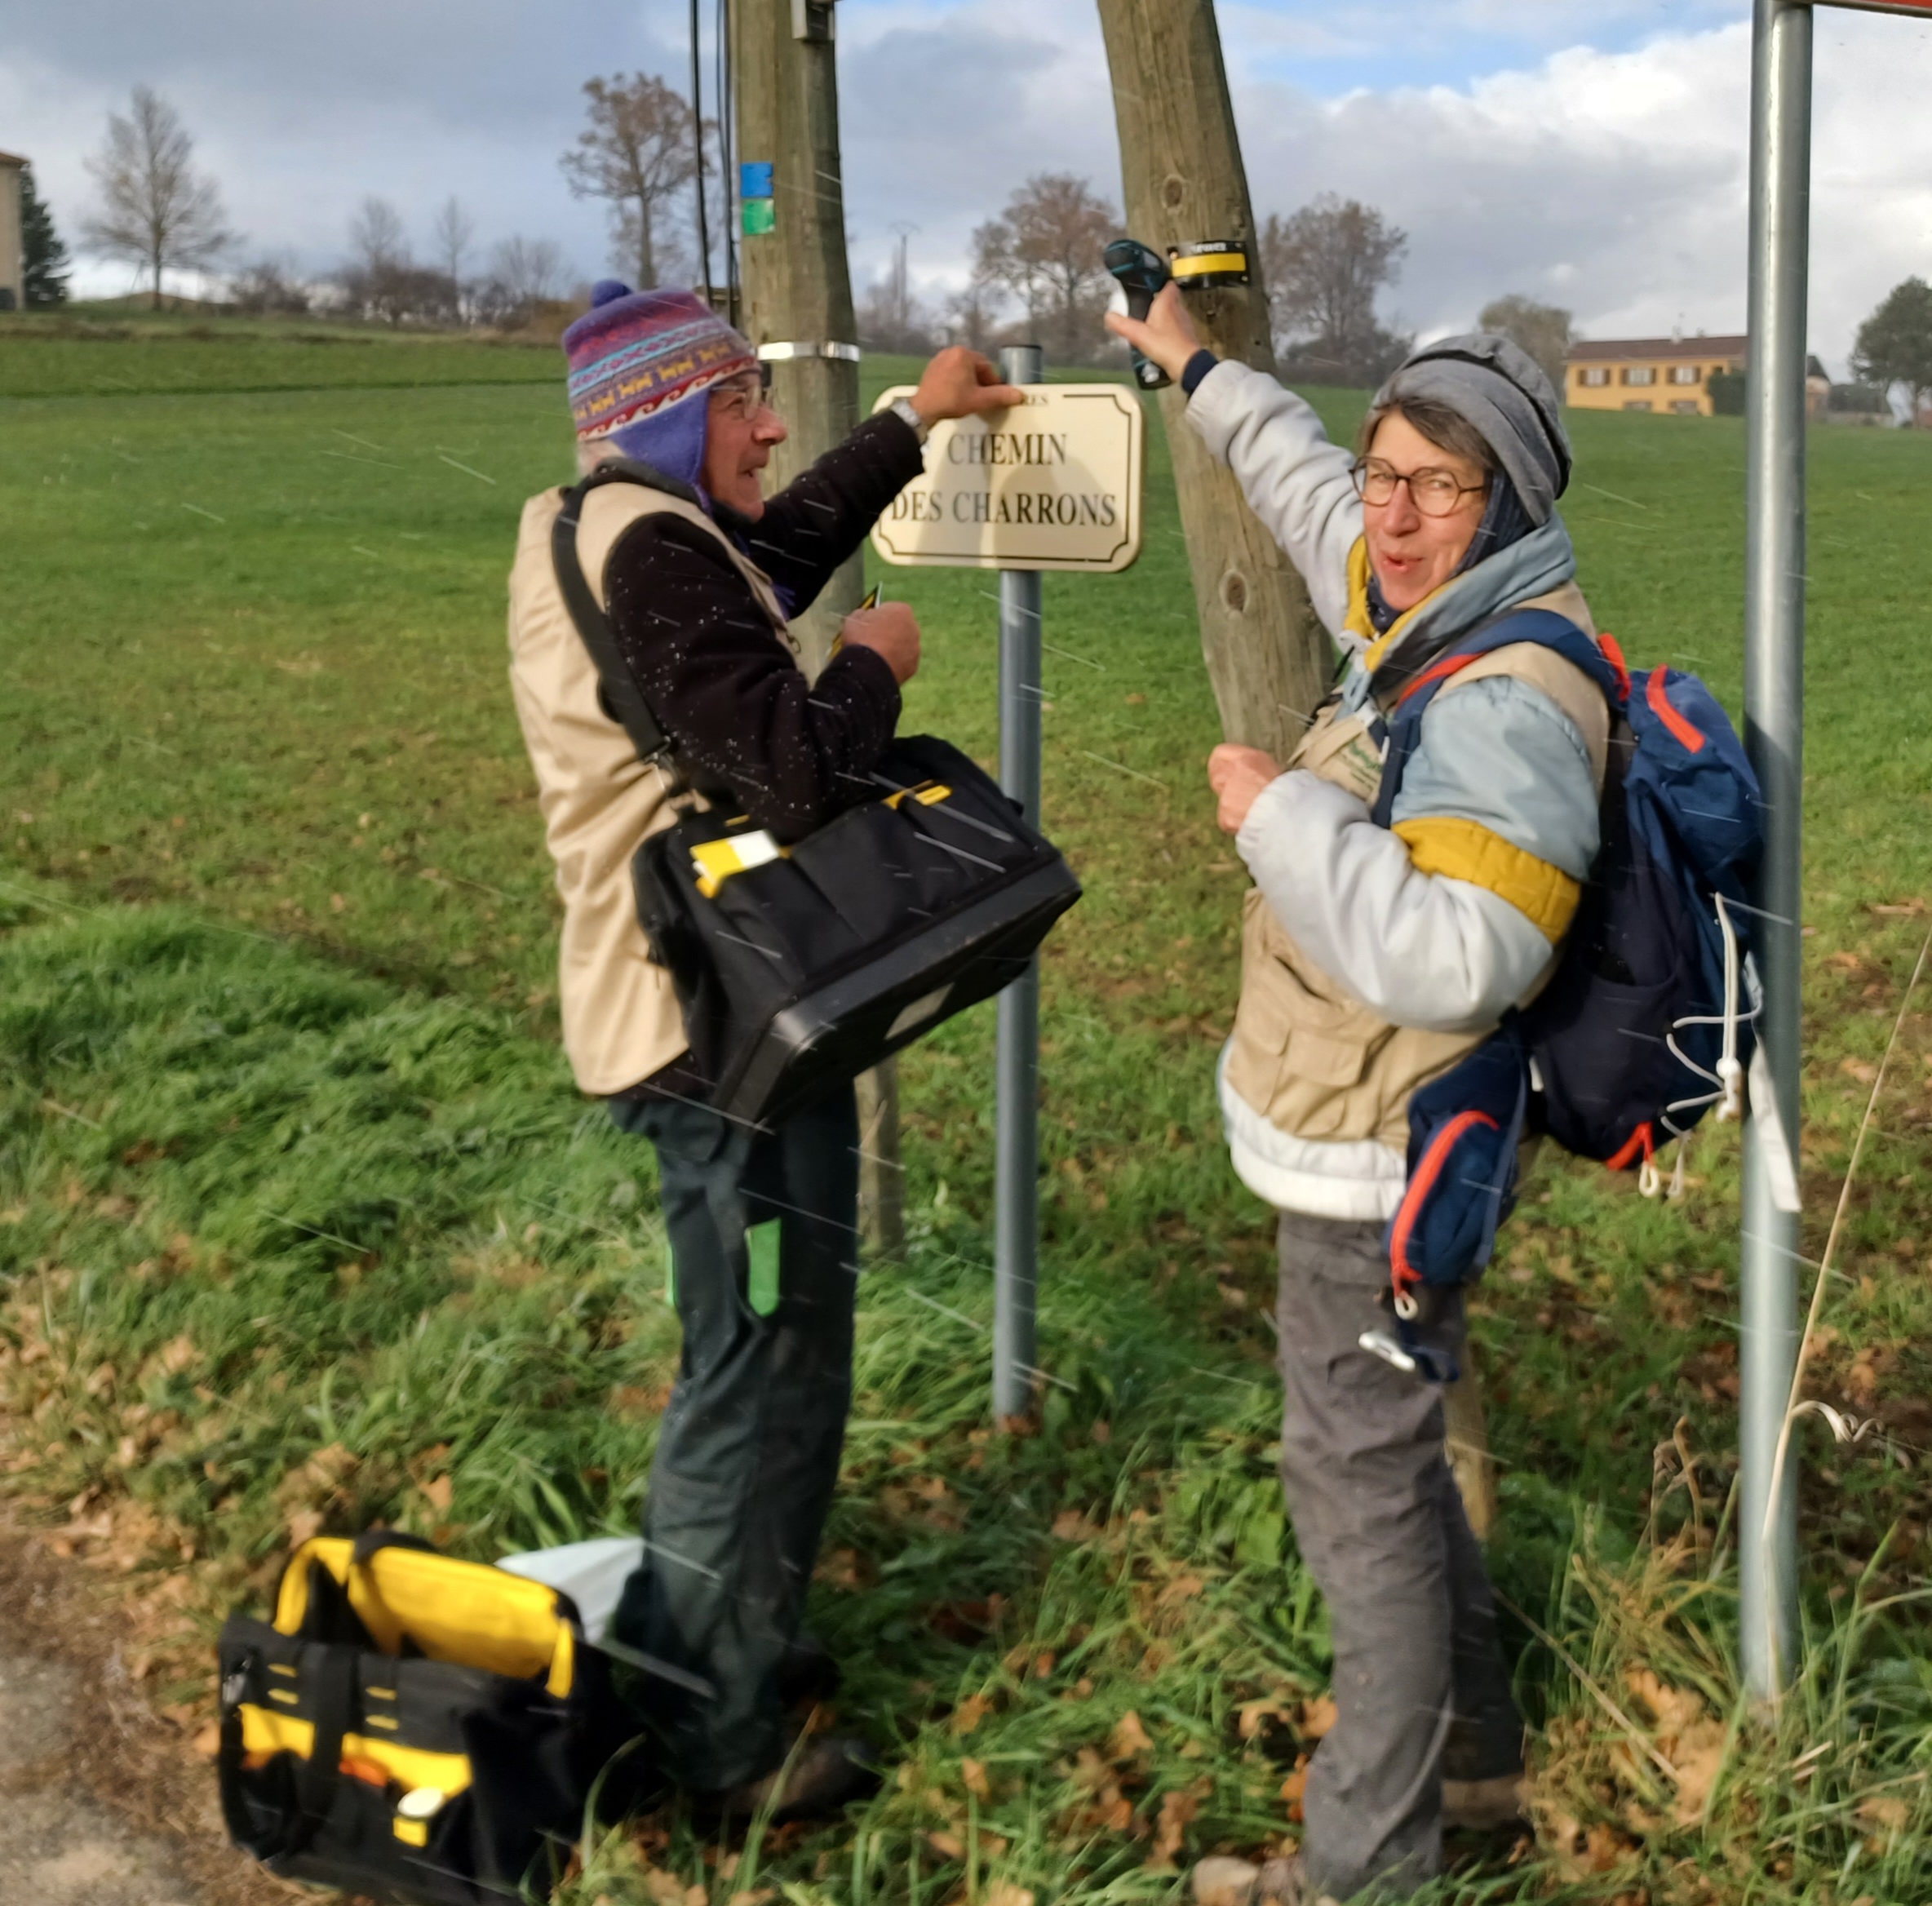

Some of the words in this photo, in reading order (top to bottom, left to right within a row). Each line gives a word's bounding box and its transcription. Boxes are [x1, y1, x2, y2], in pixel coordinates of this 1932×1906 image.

[947, 433, 1067, 465] CHEMIN
[892, 491, 942, 522] DES
[952, 493, 1116, 527] CHARRONS
